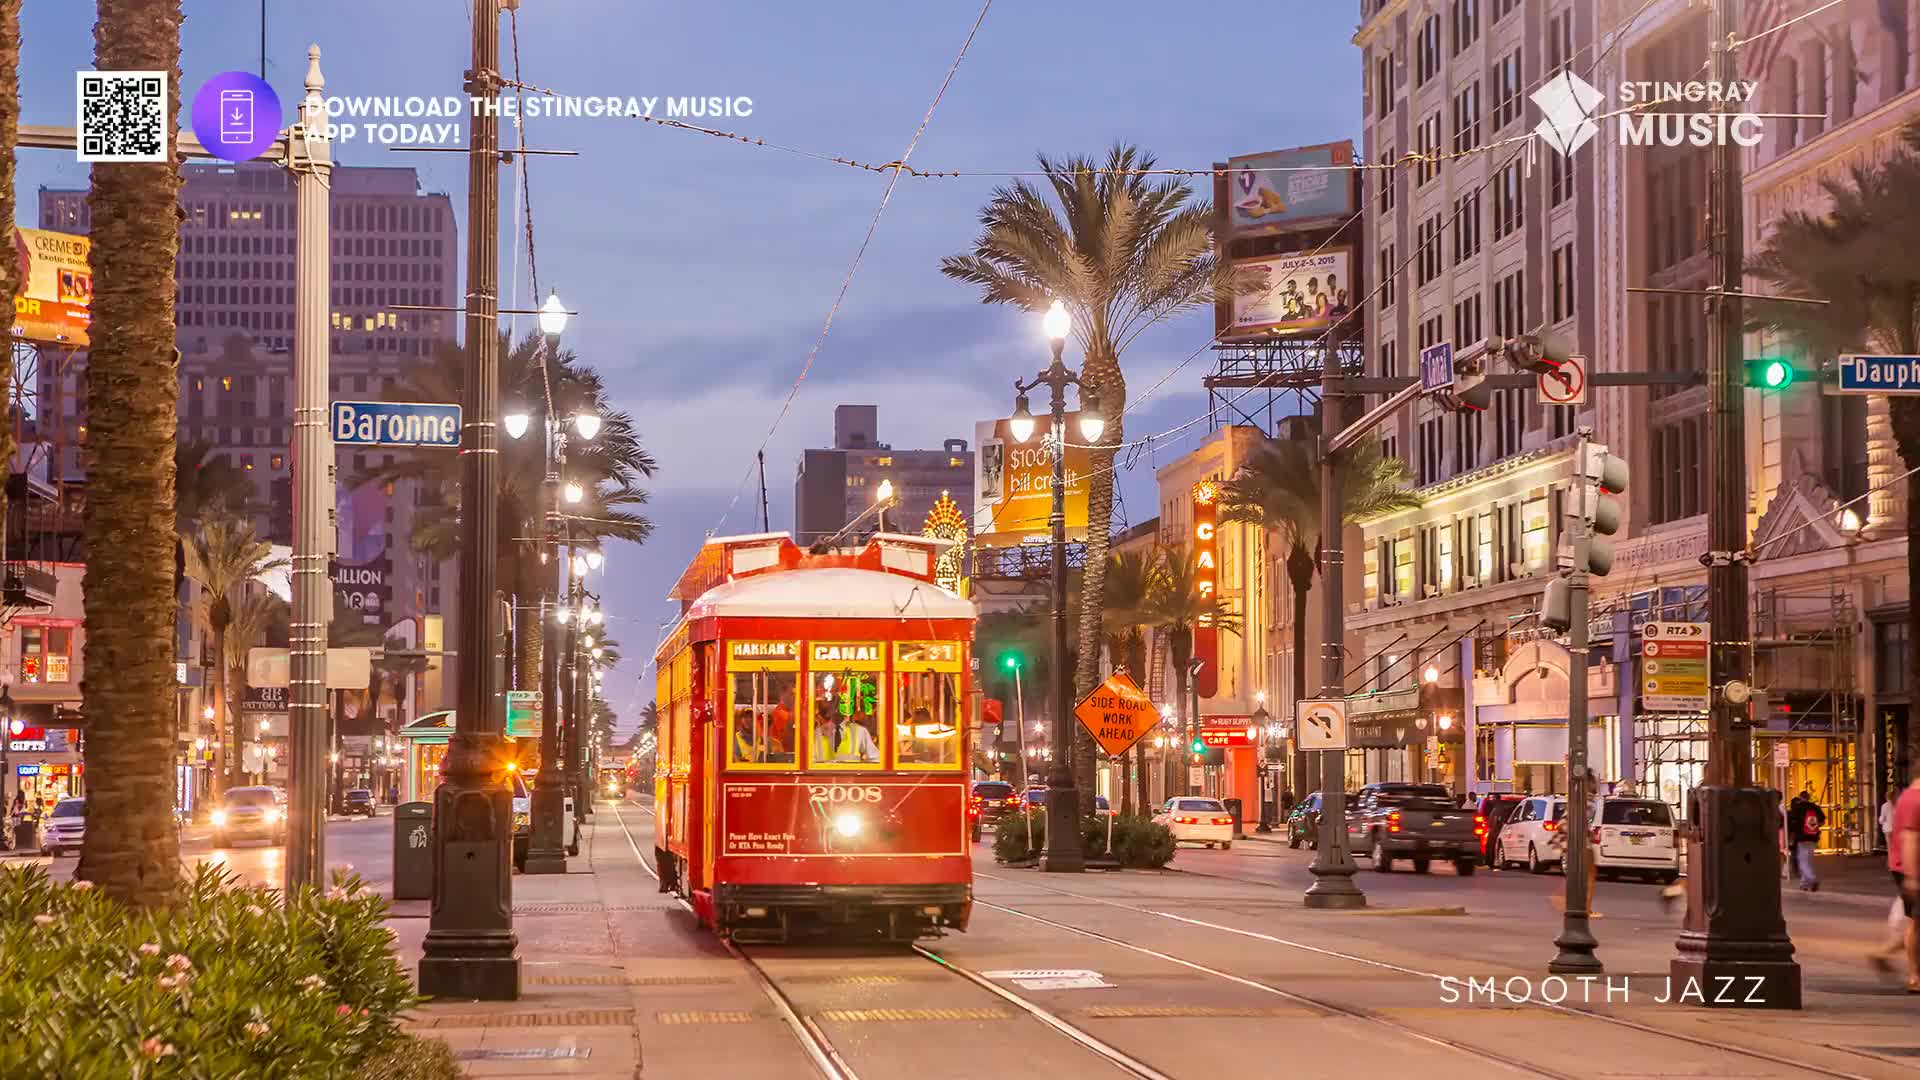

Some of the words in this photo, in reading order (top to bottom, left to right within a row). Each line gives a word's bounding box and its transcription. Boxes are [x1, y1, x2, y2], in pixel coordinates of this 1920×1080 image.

[35, 237, 72, 253] CREME
[38, 253, 64, 264] Exotic
[1281, 260, 1300, 270] JULY
[1317, 255, 1336, 265] 2015
[1427, 345, 1448, 388] Canal
[1855, 358, 1920, 388] Dauph
[337, 405, 456, 443] Baronne
[1010, 447, 1046, 471] $100
[1010, 472, 1031, 492] bill
[336, 568, 382, 585] ILLION
[1197, 522, 1215, 628] CAFE
[1666, 626, 1688, 635] RTA
[814, 645, 879, 661] CANAL
[1090, 696, 1115, 709] SIDE
[1119, 698, 1147, 712] ROAD
[1103, 712, 1133, 725] WORK
[1099, 727, 1135, 741] AHEAD
[1207, 737, 1229, 745] CAFE
[10, 740, 46, 751] GIFTS
[811, 786, 882, 803] 2008
